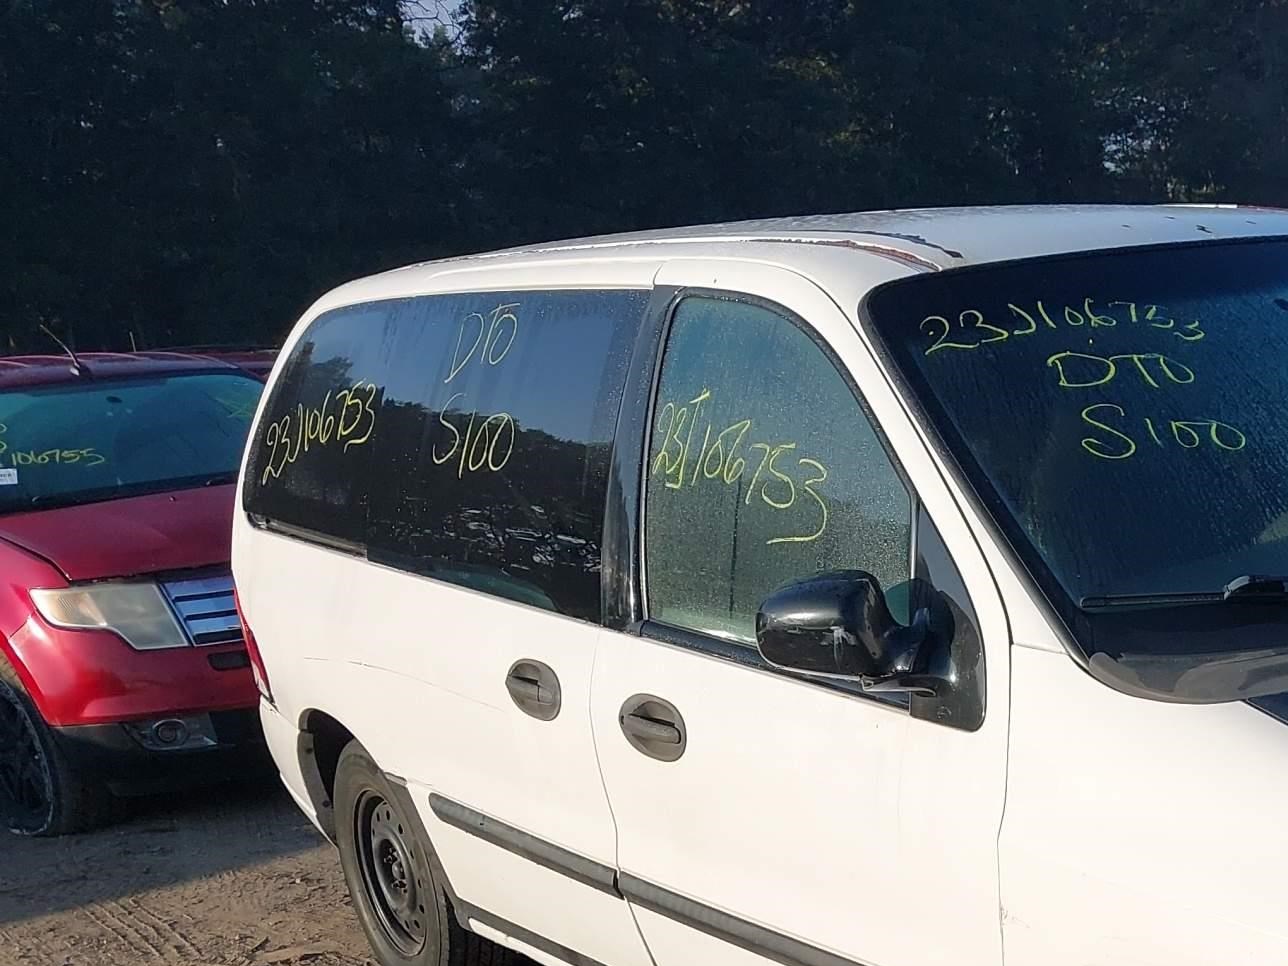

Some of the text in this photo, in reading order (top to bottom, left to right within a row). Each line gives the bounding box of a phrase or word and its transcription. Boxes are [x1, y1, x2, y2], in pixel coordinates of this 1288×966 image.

[444, 303, 521, 384] DTO
[1046, 351, 1195, 388] DTO
[433, 392, 516, 480] S100
[1081, 404, 1247, 460] S100
